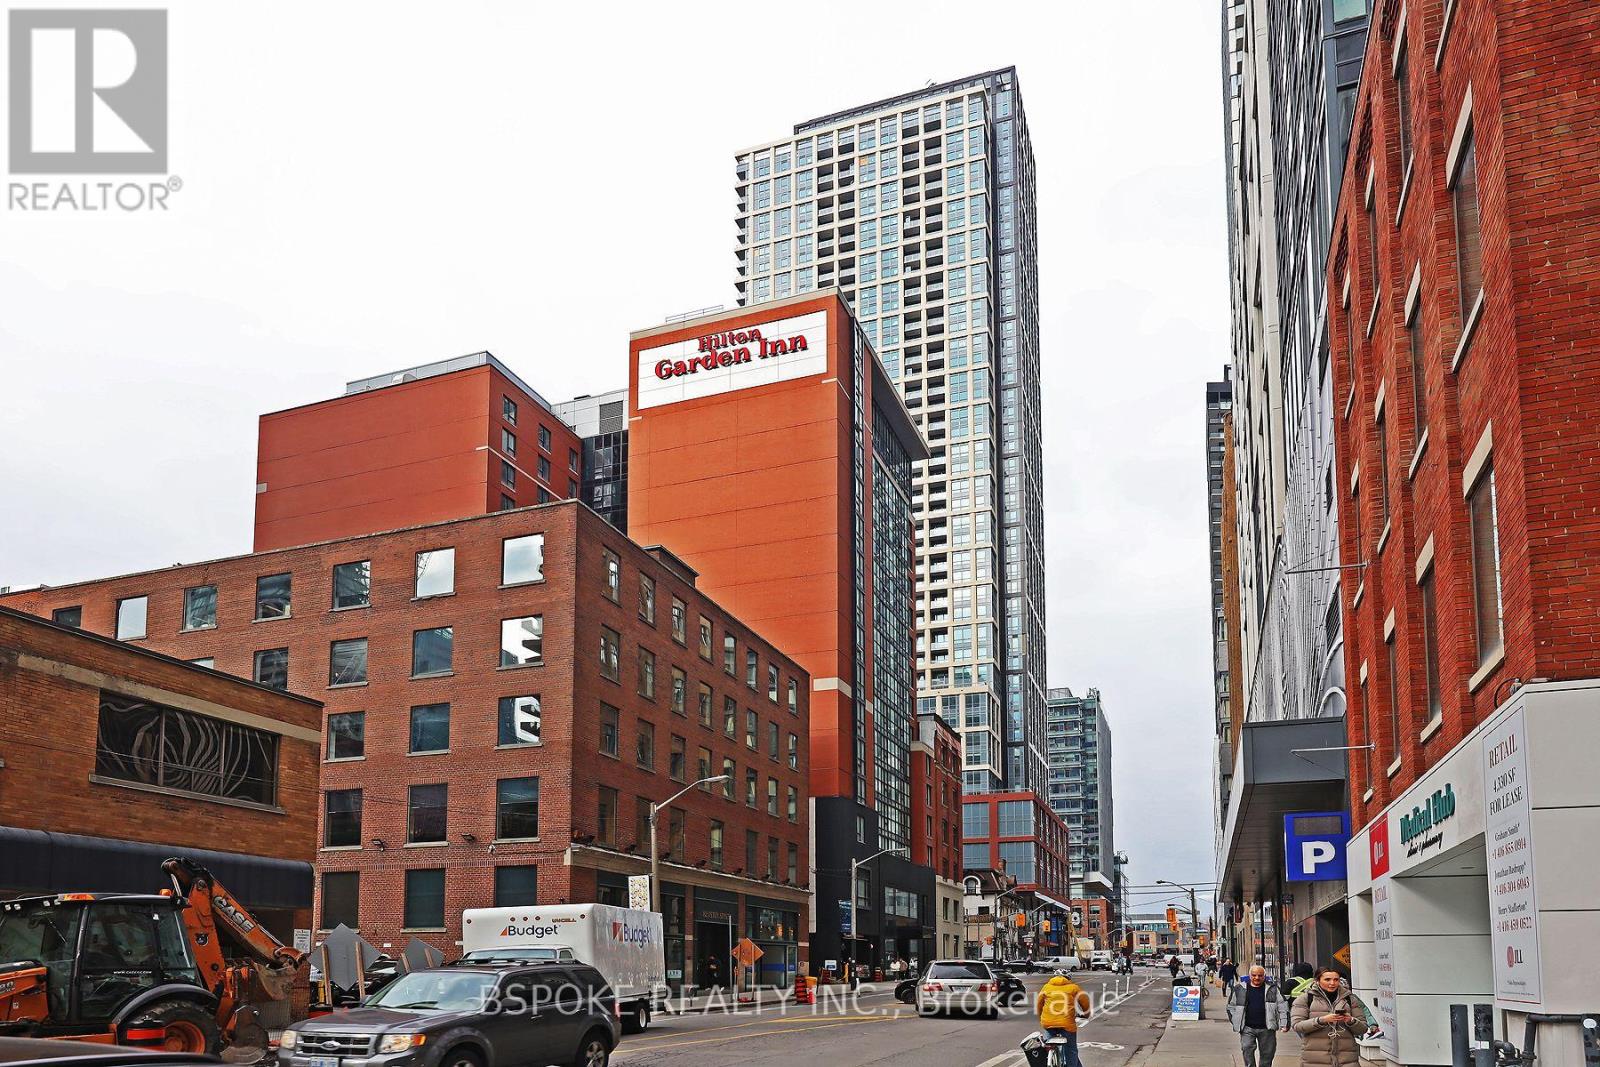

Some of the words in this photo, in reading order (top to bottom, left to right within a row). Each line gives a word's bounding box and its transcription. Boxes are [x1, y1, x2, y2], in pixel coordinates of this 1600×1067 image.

[655, 346, 752, 380] Garden
[757, 334, 809, 359] Inn
[698, 328, 763, 353] Hilton
[1489, 733, 1518, 768] RETAIL
[1400, 798, 1432, 845] Medical
[1431, 783, 1456, 825] Hub
[1490, 797, 1502, 816] FOR
[1502, 786, 1523, 809] LEASE
[1302, 841, 1336, 874] P
[213, 896, 255, 933] CASE
[508, 925, 558, 938] Budget
[623, 923, 650, 948] Budget
